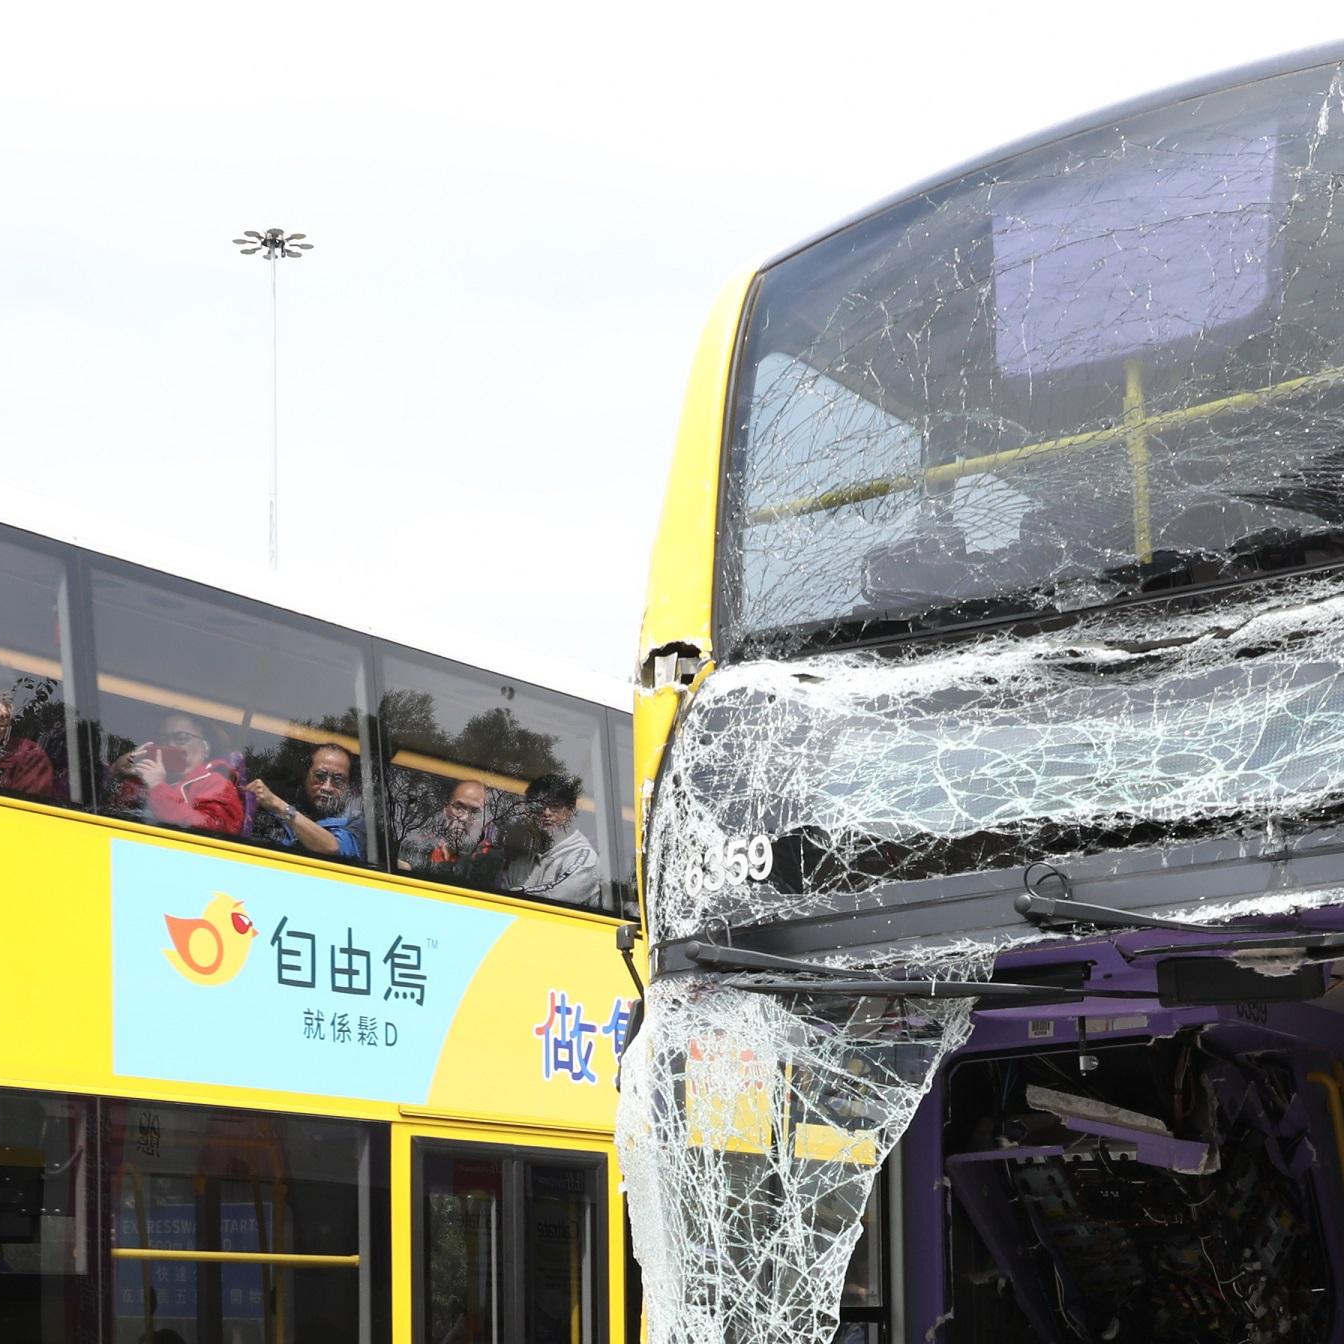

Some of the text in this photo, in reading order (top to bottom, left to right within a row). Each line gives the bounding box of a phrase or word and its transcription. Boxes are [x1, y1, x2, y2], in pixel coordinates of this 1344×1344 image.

[685, 835, 773, 897] 6359
[270, 915, 427, 1006] 自由鳥
[302, 1008, 398, 1047] 就係鬆D
